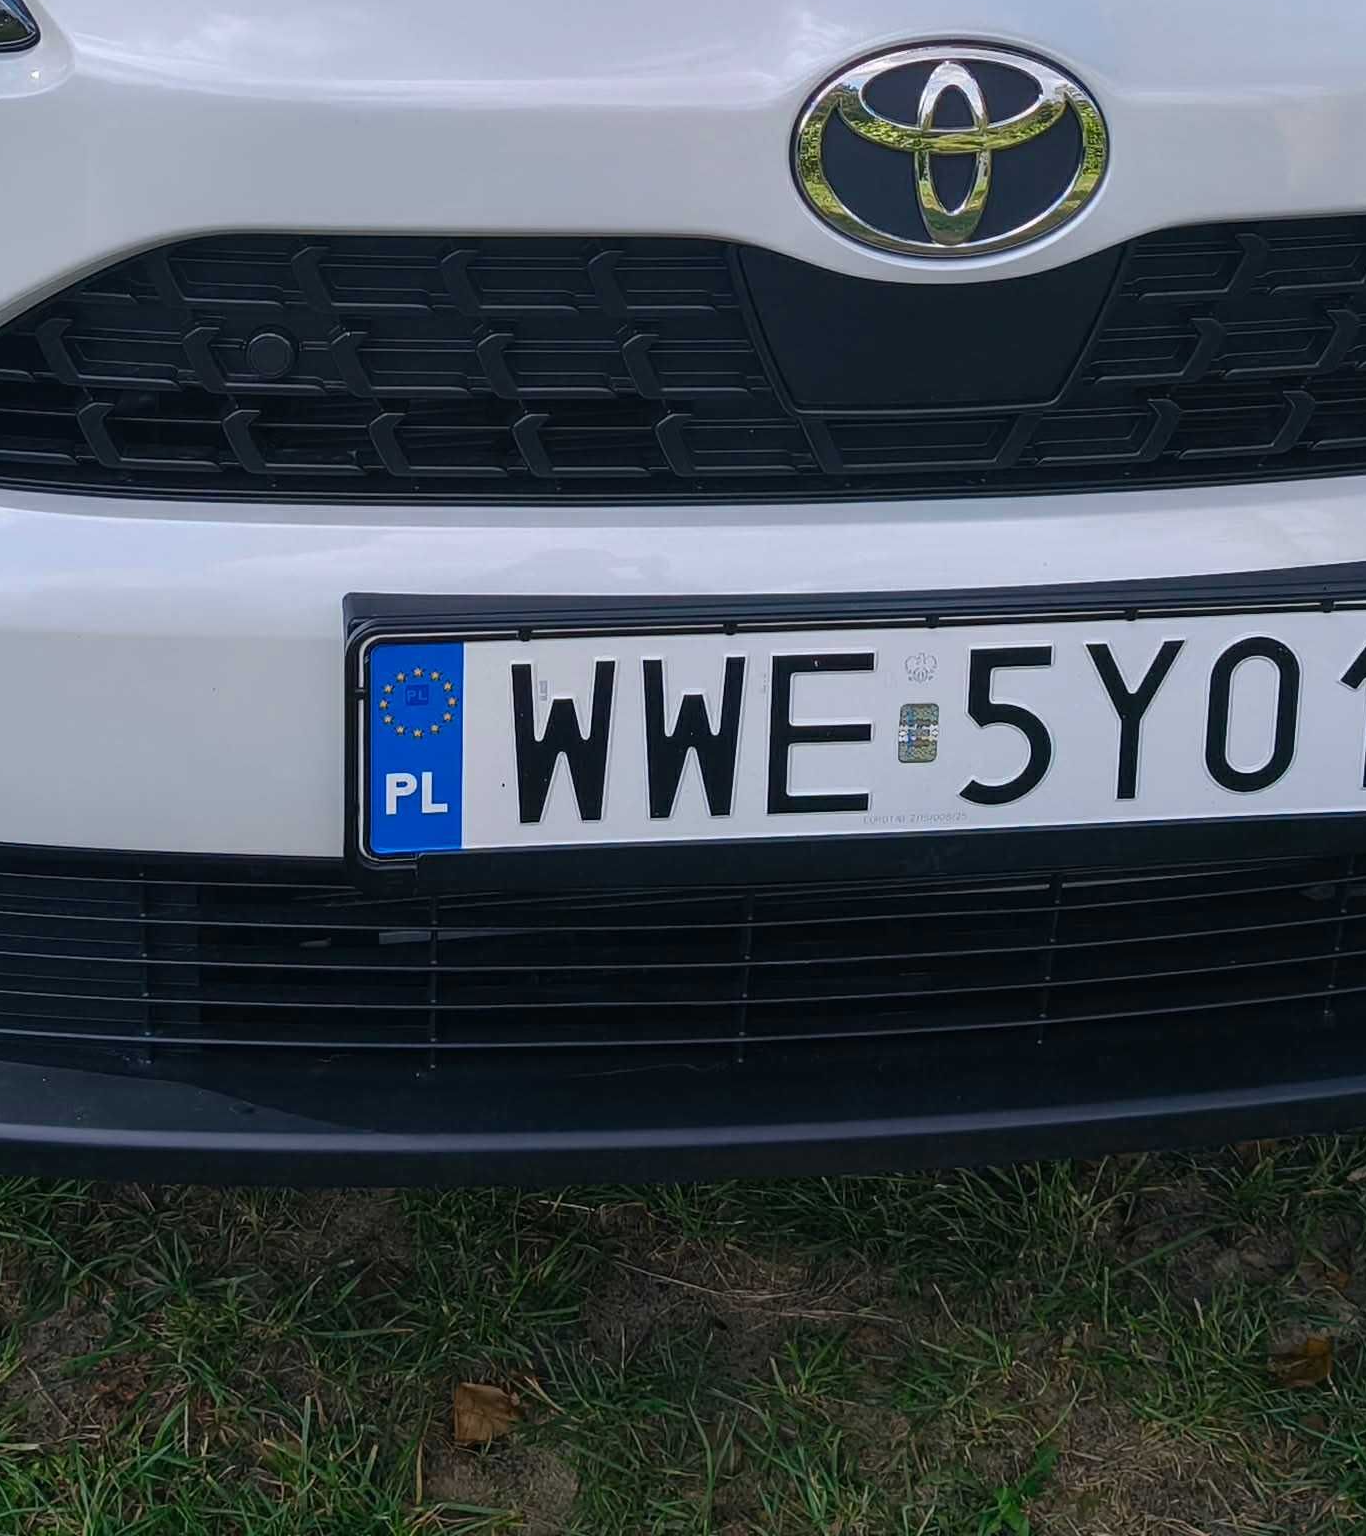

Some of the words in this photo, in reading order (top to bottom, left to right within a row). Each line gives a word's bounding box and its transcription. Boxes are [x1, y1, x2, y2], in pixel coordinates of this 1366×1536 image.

[406, 689, 428, 703] PL
[511, 652, 875, 824] WWE
[386, 771, 448, 815] PL
